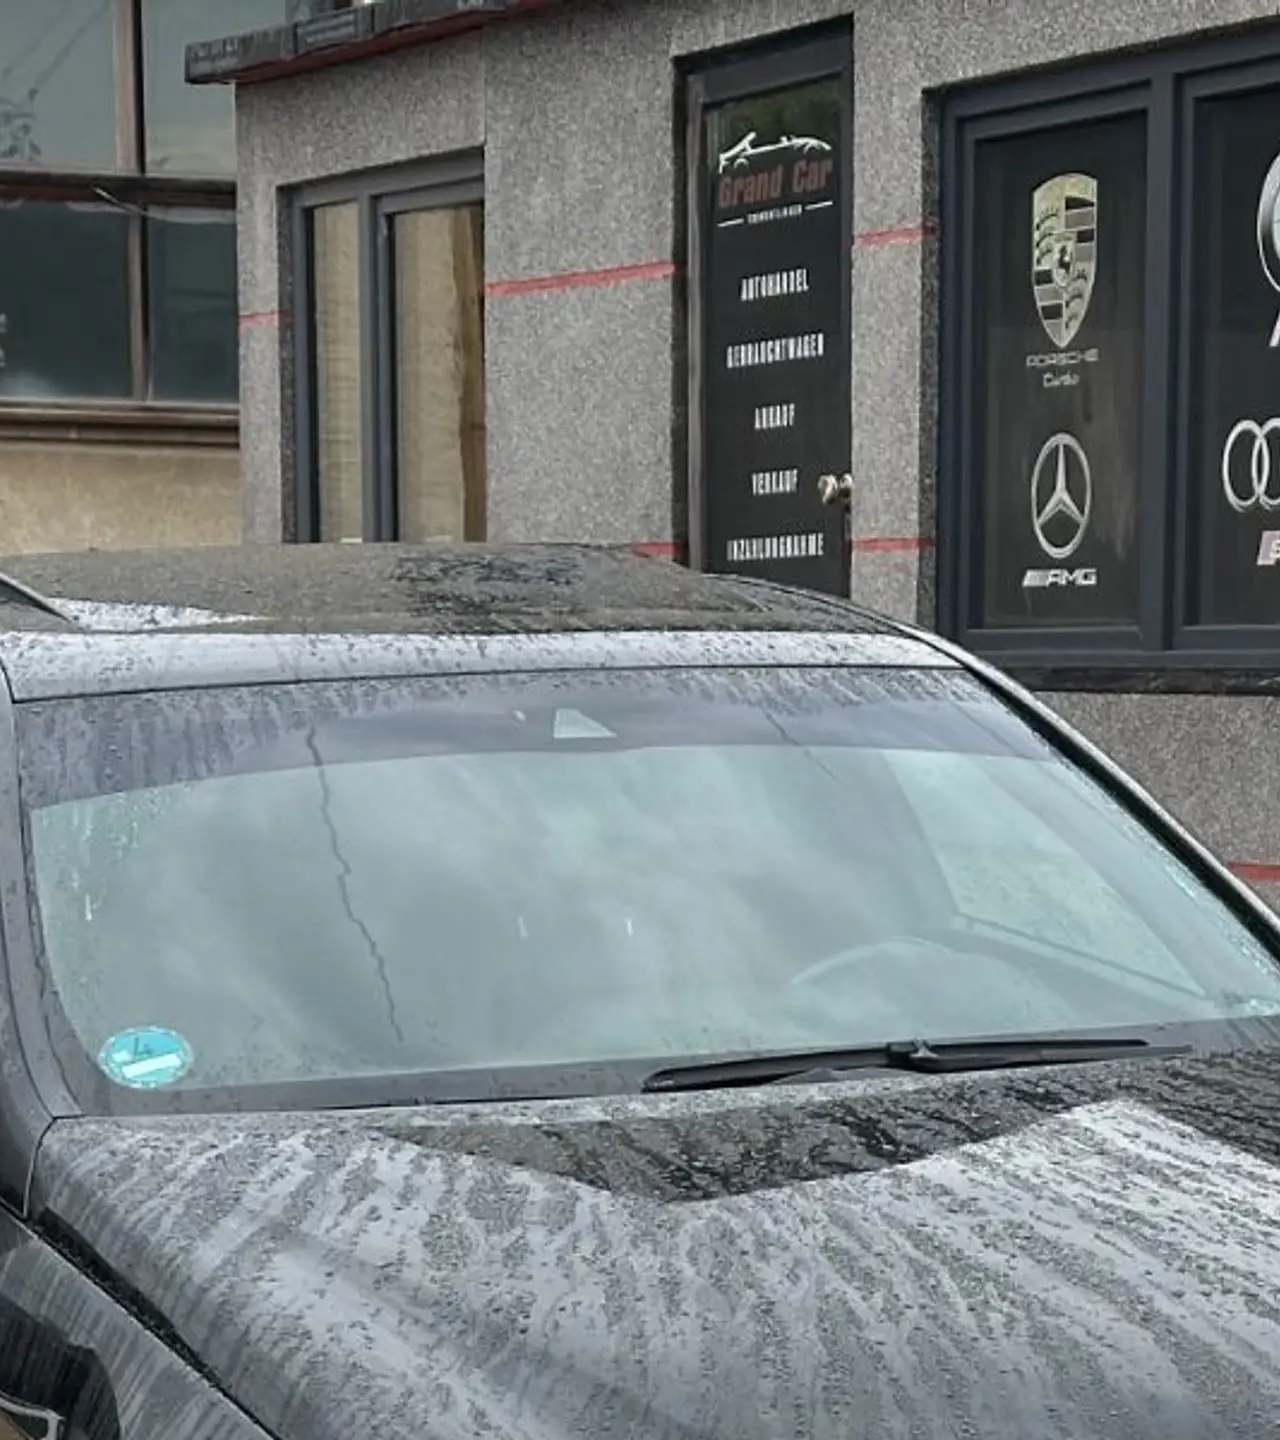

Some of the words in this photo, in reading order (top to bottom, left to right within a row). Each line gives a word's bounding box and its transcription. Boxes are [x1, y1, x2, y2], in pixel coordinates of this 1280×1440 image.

[717, 163, 785, 208] Grand
[791, 157, 833, 194] Car
[740, 268, 810, 302] AUTOHANDEL
[726, 332, 825, 369] GEBRAUCHTWAGEN
[754, 402, 796, 431] ANKAUF
[751, 467, 800, 497] VERKAUF
[1045, 568, 1098, 587] AMG
